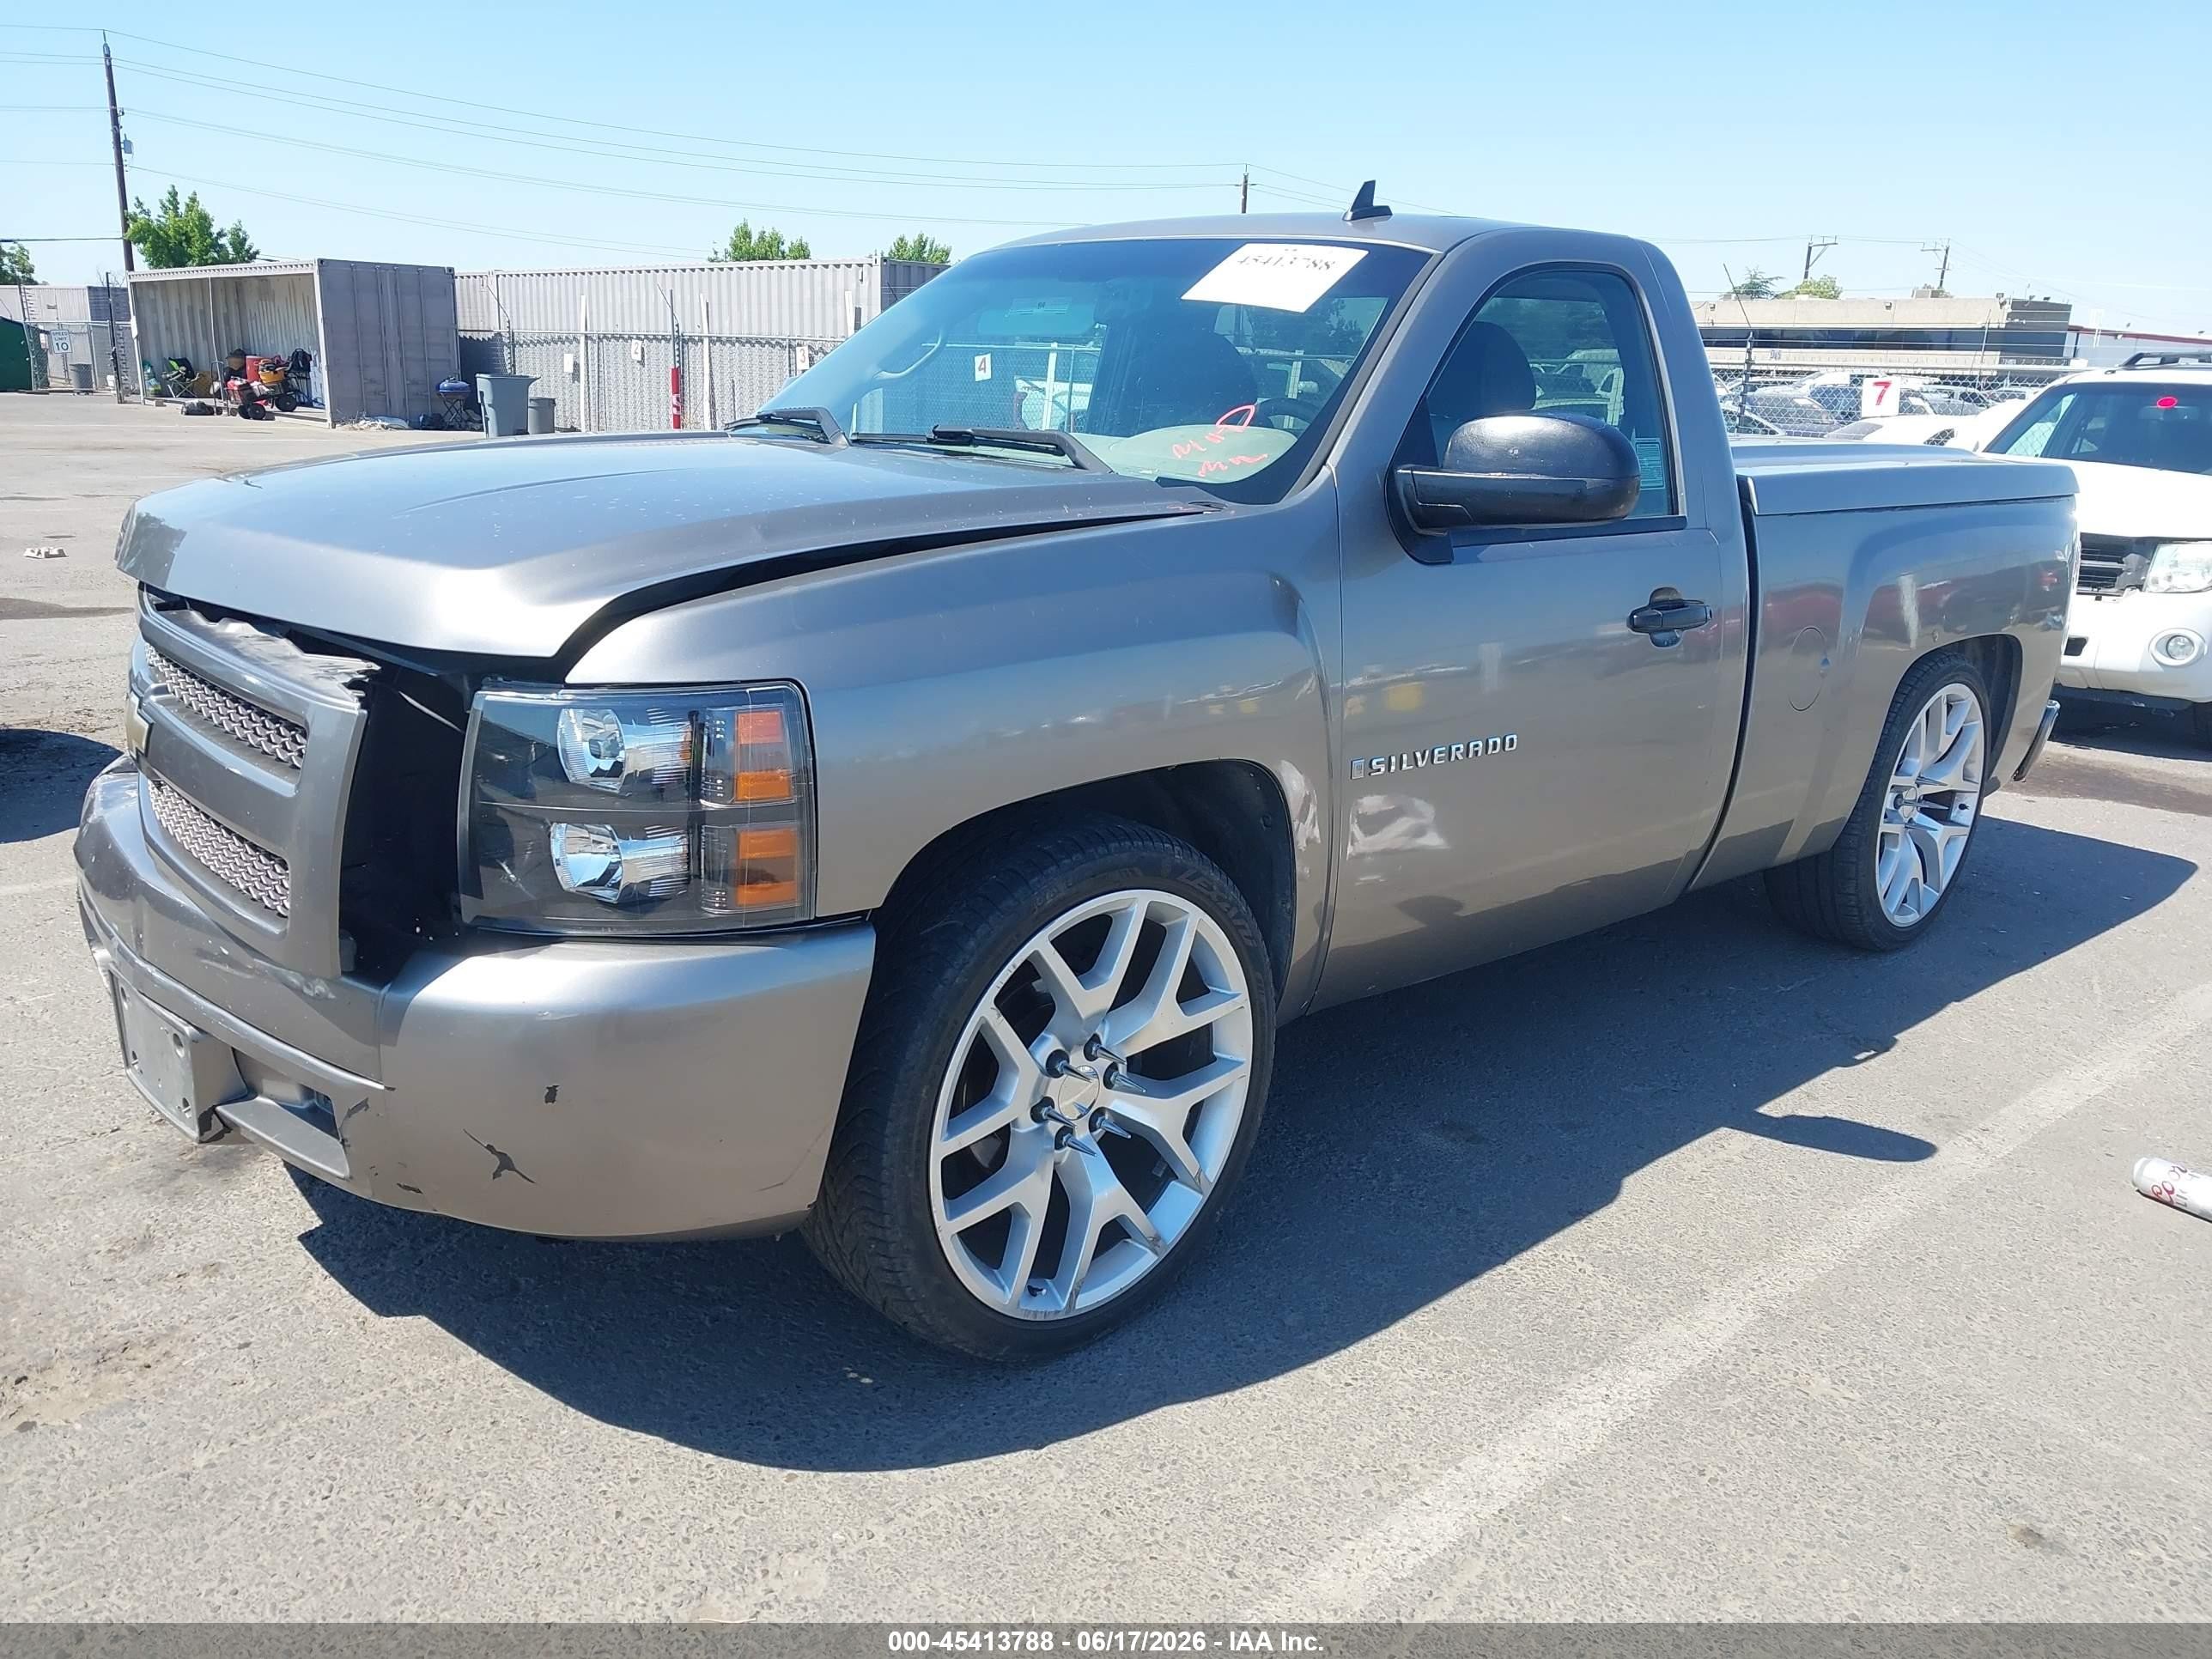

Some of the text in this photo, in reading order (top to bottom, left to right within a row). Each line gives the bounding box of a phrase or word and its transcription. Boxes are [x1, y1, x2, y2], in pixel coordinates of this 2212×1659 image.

[55, 342, 69, 351] 10
[799, 349, 805, 362] 3
[978, 357, 987, 374] 4
[1873, 380, 1893, 406] 7
[1369, 733, 1518, 777] SILVERADO
